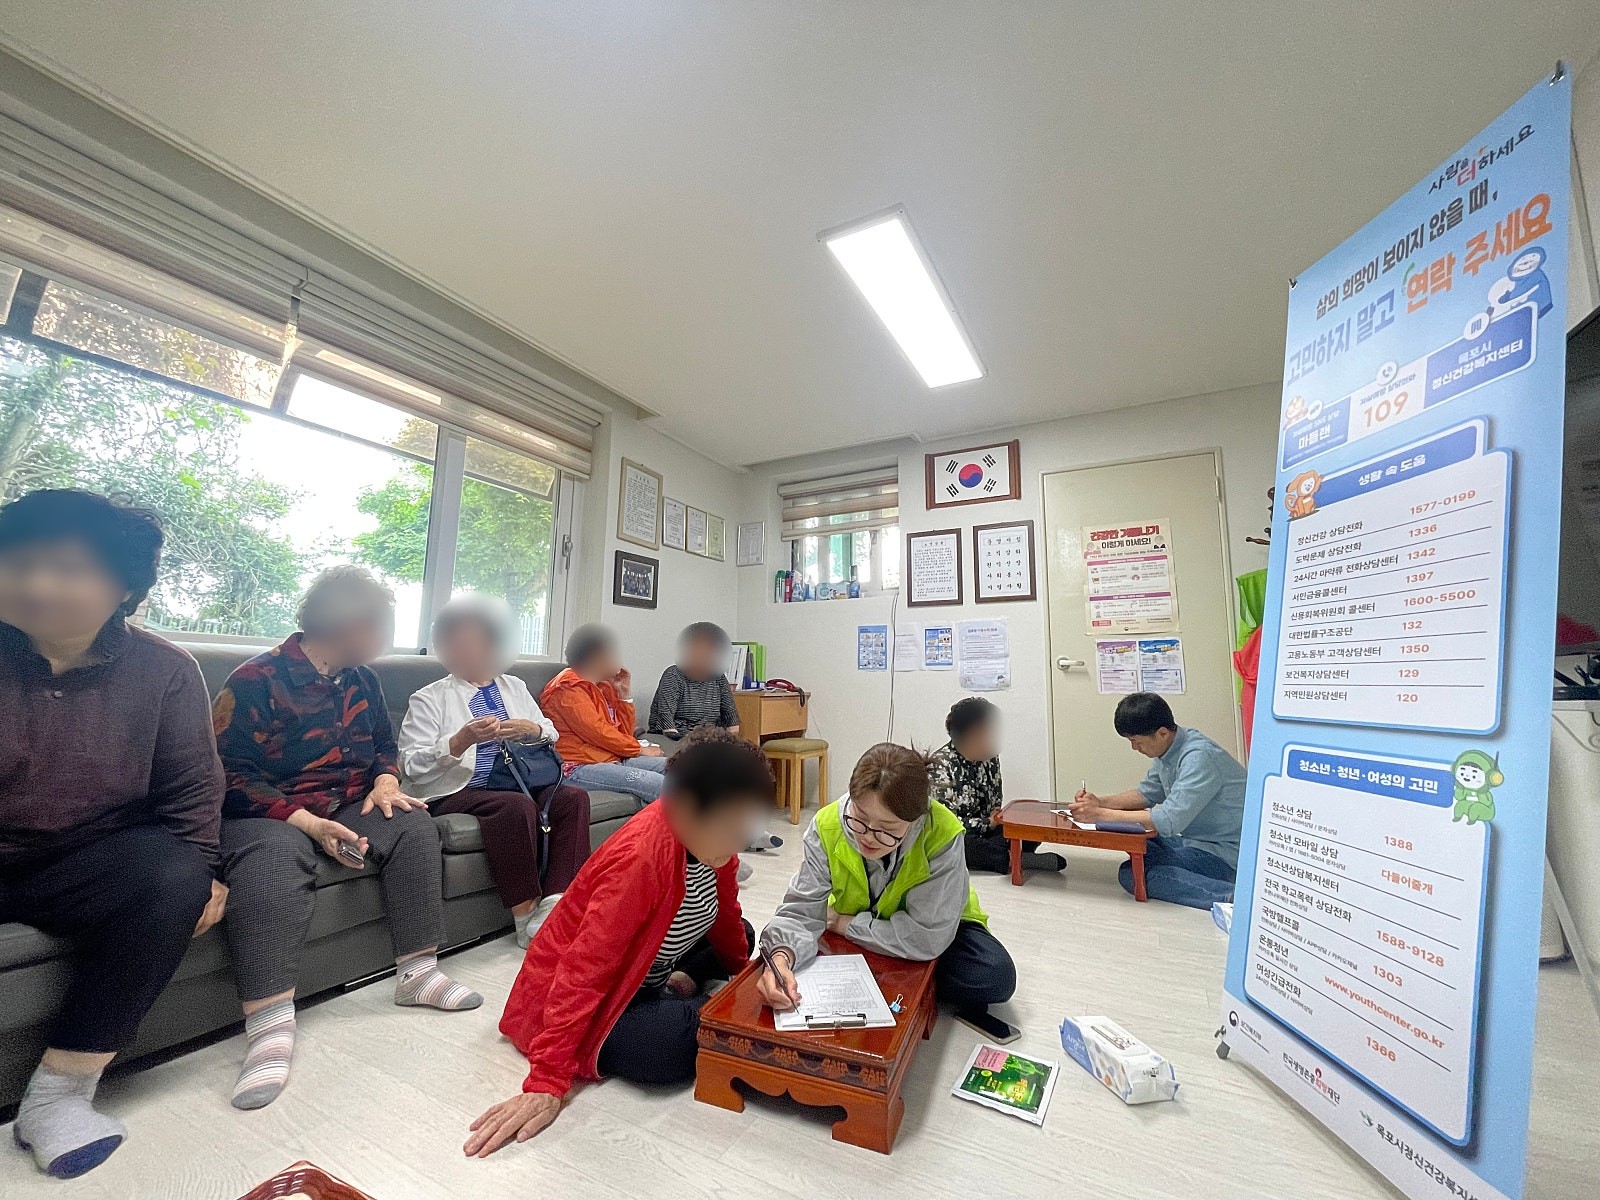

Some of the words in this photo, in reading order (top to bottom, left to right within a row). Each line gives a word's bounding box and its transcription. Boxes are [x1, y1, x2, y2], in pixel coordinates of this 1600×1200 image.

[1316, 286, 1339, 321] 삶의
[1341, 256, 1379, 301] 희망이
[1381, 223, 1425, 275] 보이지
[1428, 196, 1464, 243] 않을
[1468, 178, 1499, 216] 때,
[1287, 317, 1351, 387] 고민하지
[1356, 288, 1395, 347] 말고
[1406, 251, 1456, 315] 연락
[1462, 192, 1553, 277] 주세요
[1459, 340, 1492, 364] 목포시
[1432, 339, 1523, 390] 정신건강복지센터
[1364, 391, 1409, 428] 109
[1298, 424, 1331, 449] 마들랜
[1358, 469, 1383, 486] 생활
[1385, 465, 1397, 476] 속
[1400, 453, 1427, 473] 도움
[1409, 490, 1477, 515] 1577-0199
[1297, 530, 1327, 546] 정신건강
[1329, 521, 1363, 538] 상담전화
[1408, 524, 1438, 538] 1336
[1295, 549, 1326, 565] 도박문제
[1328, 541, 1362, 557] 상담전화
[1407, 548, 1436, 561] 1342
[1294, 571, 1318, 583] 24시간
[1319, 565, 1344, 579] 마약류
[1345, 554, 1399, 574] 전화상담센터
[1405, 571, 1434, 584] 1397
[1292, 585, 1348, 602] 서민금융콜센터
[1403, 589, 1476, 607] 1600-5500
[1290, 606, 1346, 621] 신용회복위원회
[1348, 602, 1376, 615] 콜센터
[1288, 626, 1354, 641] 대한법률구조공단
[1402, 620, 1423, 631] 132
[1287, 647, 1326, 660] 고용노동부
[1327, 646, 1382, 658] 고객상담센터
[1400, 644, 1430, 654] 1350
[1285, 669, 1349, 680] 보건복지상담센터
[1398, 669, 1420, 678] 129
[1284, 690, 1348, 702] 지역민원상담센터
[1397, 693, 1419, 703] 120
[1409, 777, 1439, 795] 고민
[1272, 801, 1294, 816] 청소년
[1296, 808, 1313, 820] 상담
[1269, 829, 1292, 845] 청소년
[1293, 837, 1318, 853] 모바일
[1321, 845, 1339, 859] 상담
[1384, 836, 1413, 851] 1388
[1266, 857, 1340, 893] 청소년상담복지센터
[1381, 869, 1434, 896] 다들어줄개
[1264, 878, 1280, 891] 전국
[1281, 884, 1314, 907] 학교폭력
[1315, 899, 1352, 923] 상담전화
[1262, 905, 1300, 932] 국방헬프콜
[1259, 934, 1289, 958] 온통청년
[1376, 929, 1445, 968] 1588-9128
[1256, 963, 1302, 998] 여성긴급전화
[1373, 964, 1403, 988] 1303
[1324, 975, 1446, 1050] www.youthcenter.go.kr
[1366, 1036, 1397, 1062] 1366
[1282, 1051, 1341, 1105] 한국생명존중희망재단
